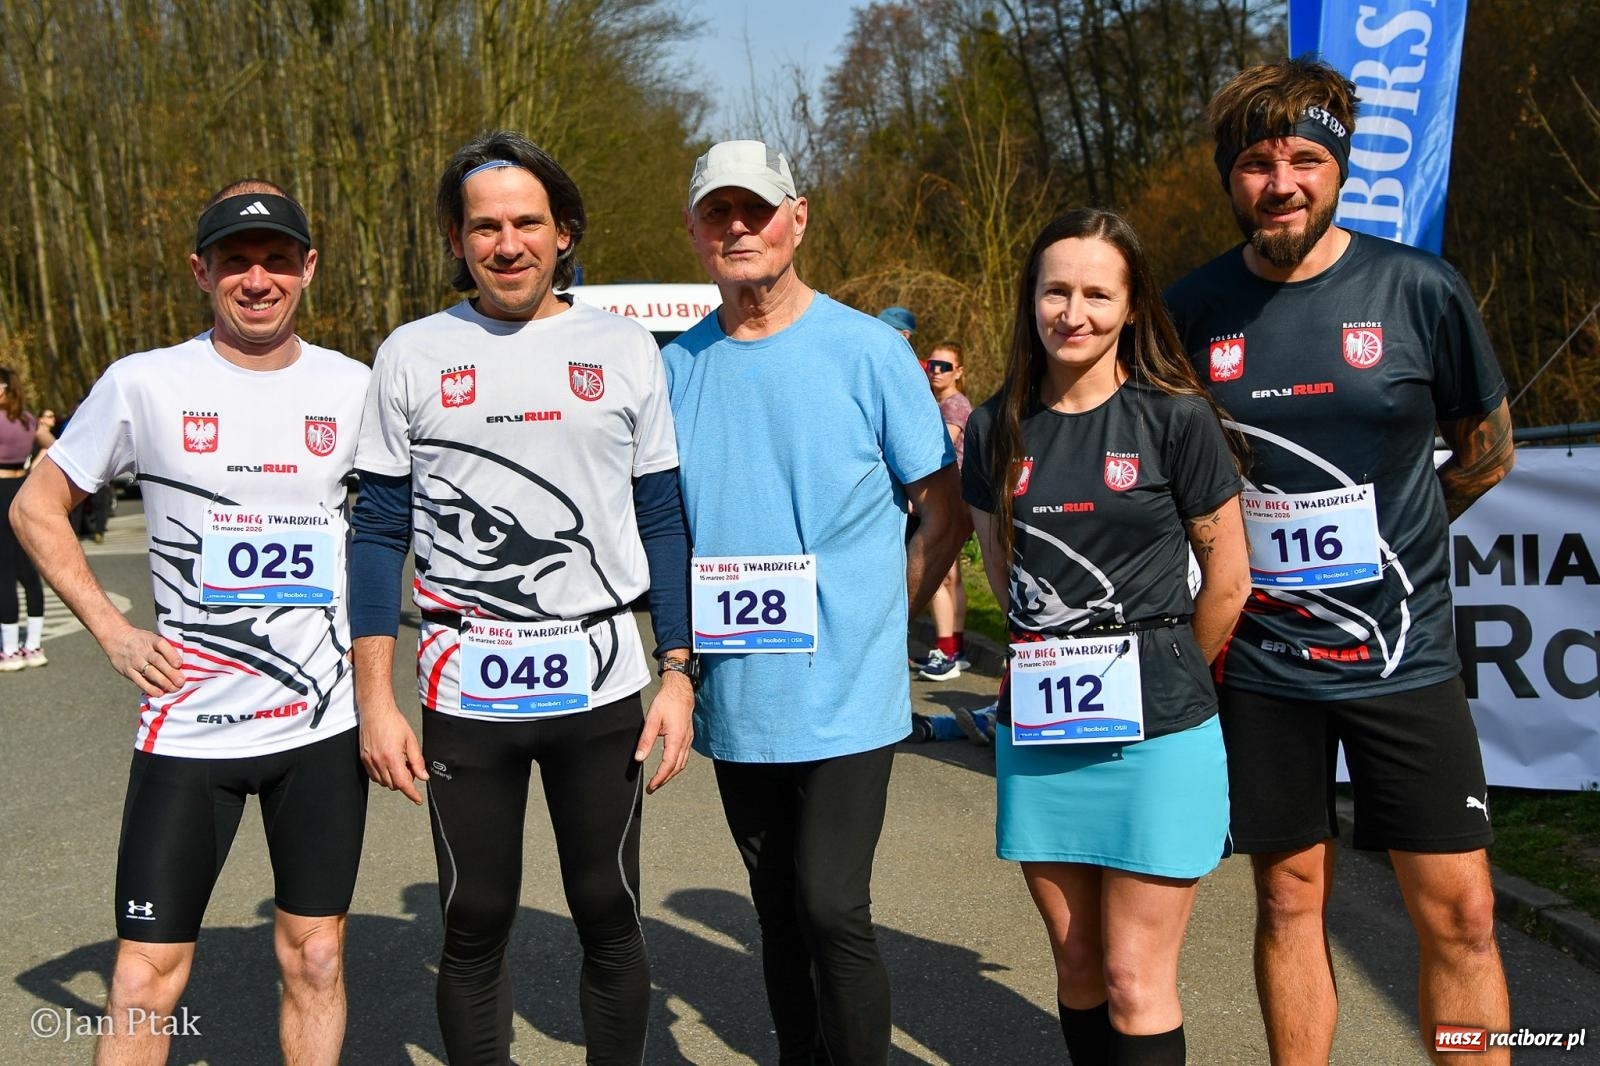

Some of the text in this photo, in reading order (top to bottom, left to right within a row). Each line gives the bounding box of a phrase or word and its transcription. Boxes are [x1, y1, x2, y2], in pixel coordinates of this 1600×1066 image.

[1335, 0, 1434, 242] BORS
[1342, 320, 1382, 328] RACIBÓRZ
[1210, 332, 1244, 343] POLSKA
[441, 364, 475, 374] POLSKA
[568, 361, 603, 369] RACIBÓRZ
[1246, 493, 1364, 510] XIV BIEG TWARDZIELA
[213, 513, 329, 525] XIV BIEG TWARDZIELA
[1271, 525, 1343, 562] 116
[228, 542, 314, 579] 025
[700, 562, 805, 573] XIV BIEG TWARDZIELA
[1453, 533, 1600, 587] MIA
[718, 590, 787, 625] 128
[469, 625, 579, 638] XIV BIEG TWARDZIELA
[1018, 644, 1121, 659] XIV BIEG TWARDZIEL
[1454, 604, 1600, 700] Ra
[480, 654, 568, 689] 048
[1038, 674, 1104, 714] 112
